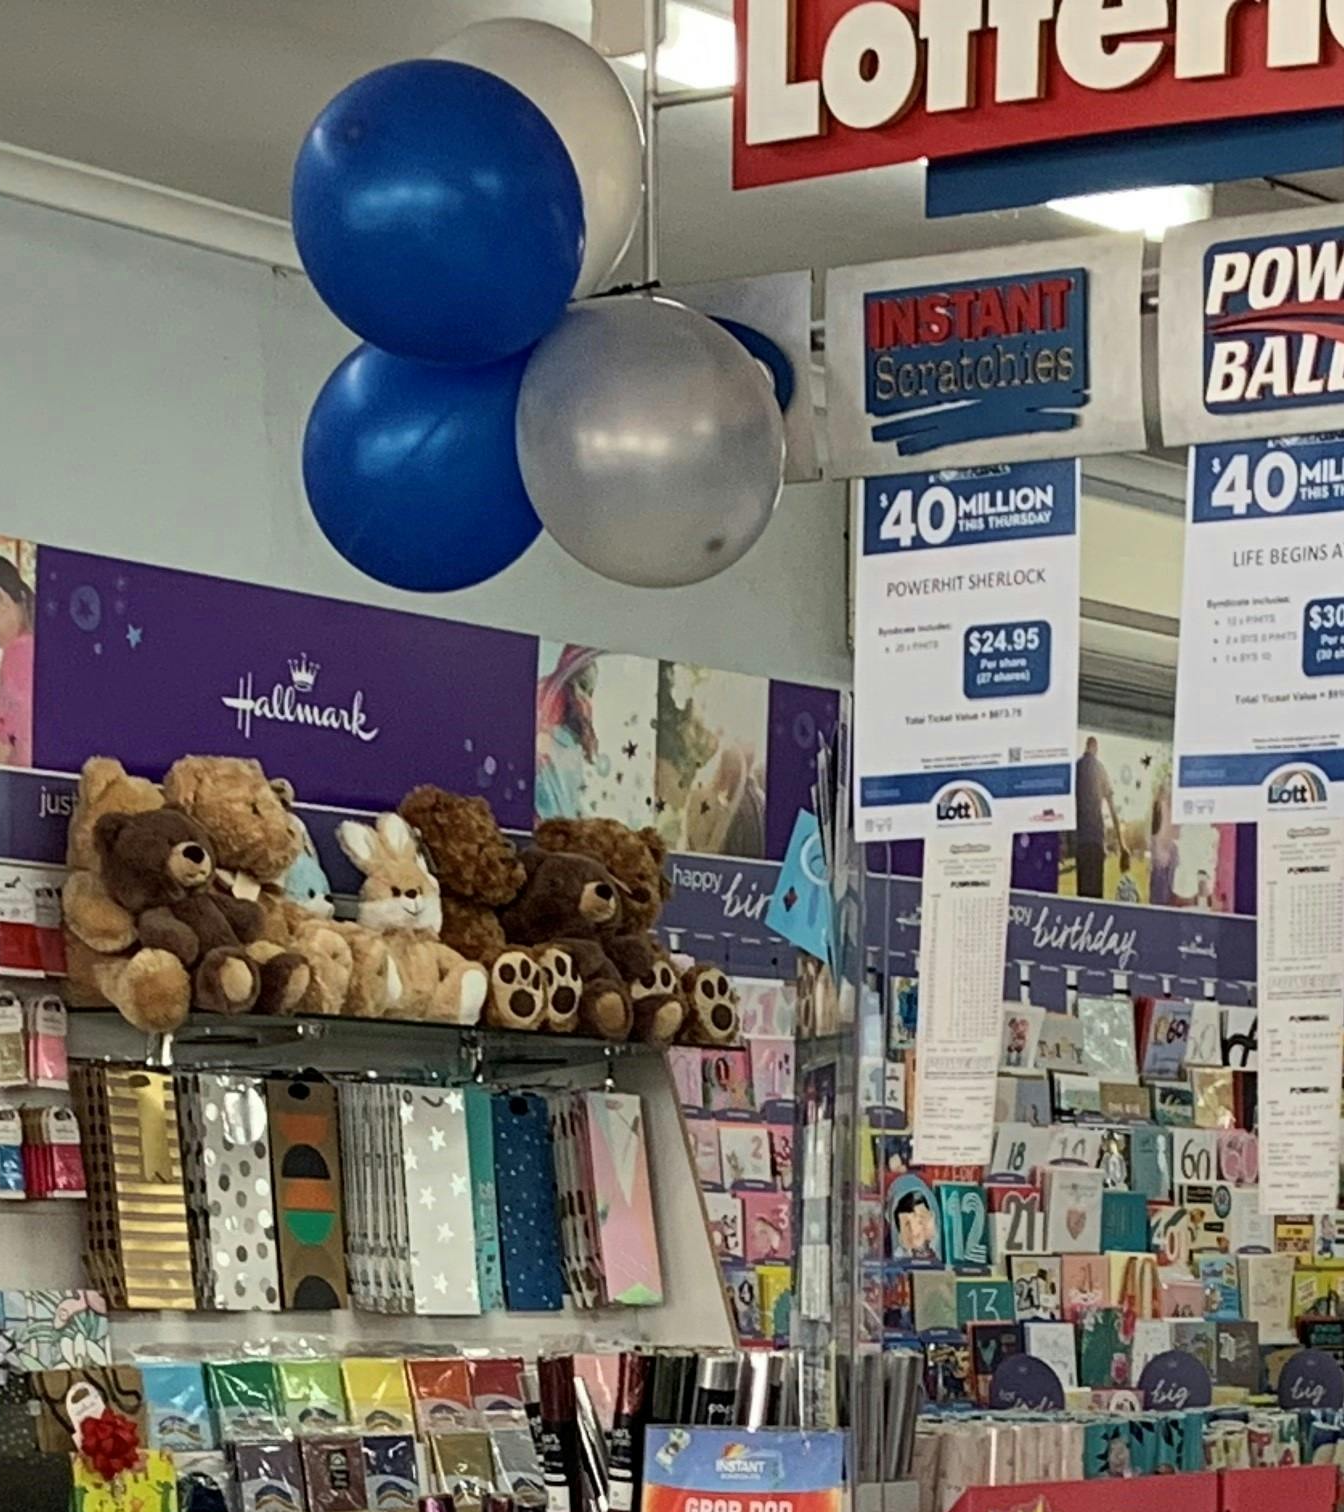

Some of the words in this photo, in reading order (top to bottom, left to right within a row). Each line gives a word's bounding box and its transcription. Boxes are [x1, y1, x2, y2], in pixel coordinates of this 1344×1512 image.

[867, 277, 1074, 352] INSTANT
[874, 343, 1076, 401] Scratchies
[1209, 450, 1299, 515] $40
[1298, 486, 1331, 501] THIS
[879, 485, 957, 548] $40
[957, 484, 1055, 517] MILLION
[957, 517, 985, 533] THIS
[987, 511, 1053, 529] THURSDAY
[1232, 549, 1265, 568] LIFE
[1269, 543, 1329, 565] BEGINS
[886, 575, 966, 598] POWERHIT
[967, 567, 1047, 591] SHERLOCK
[968, 626, 1041, 657] $24.95
[1320, 633, 1339, 647] Per
[979, 657, 998, 671] Per
[999, 656, 1028, 670] share
[993, 668, 1032, 684] shares)
[222, 672, 380, 744] Hallmark
[38, 785, 77, 821] jus
[936, 800, 972, 820] Lott
[1267, 784, 1308, 806] Lott
[1031, 906, 1138, 969] birthday
[1005, 1140, 1027, 1170] 18
[777, 1204, 791, 1231] 3
[944, 1190, 988, 1265] 12
[1001, 1190, 1039, 1252] 21
[966, 1287, 1001, 1321] 13
[1149, 1378, 1192, 1408] big
[1291, 1375, 1327, 1406] big
[714, 1459, 767, 1474] INSTANT
